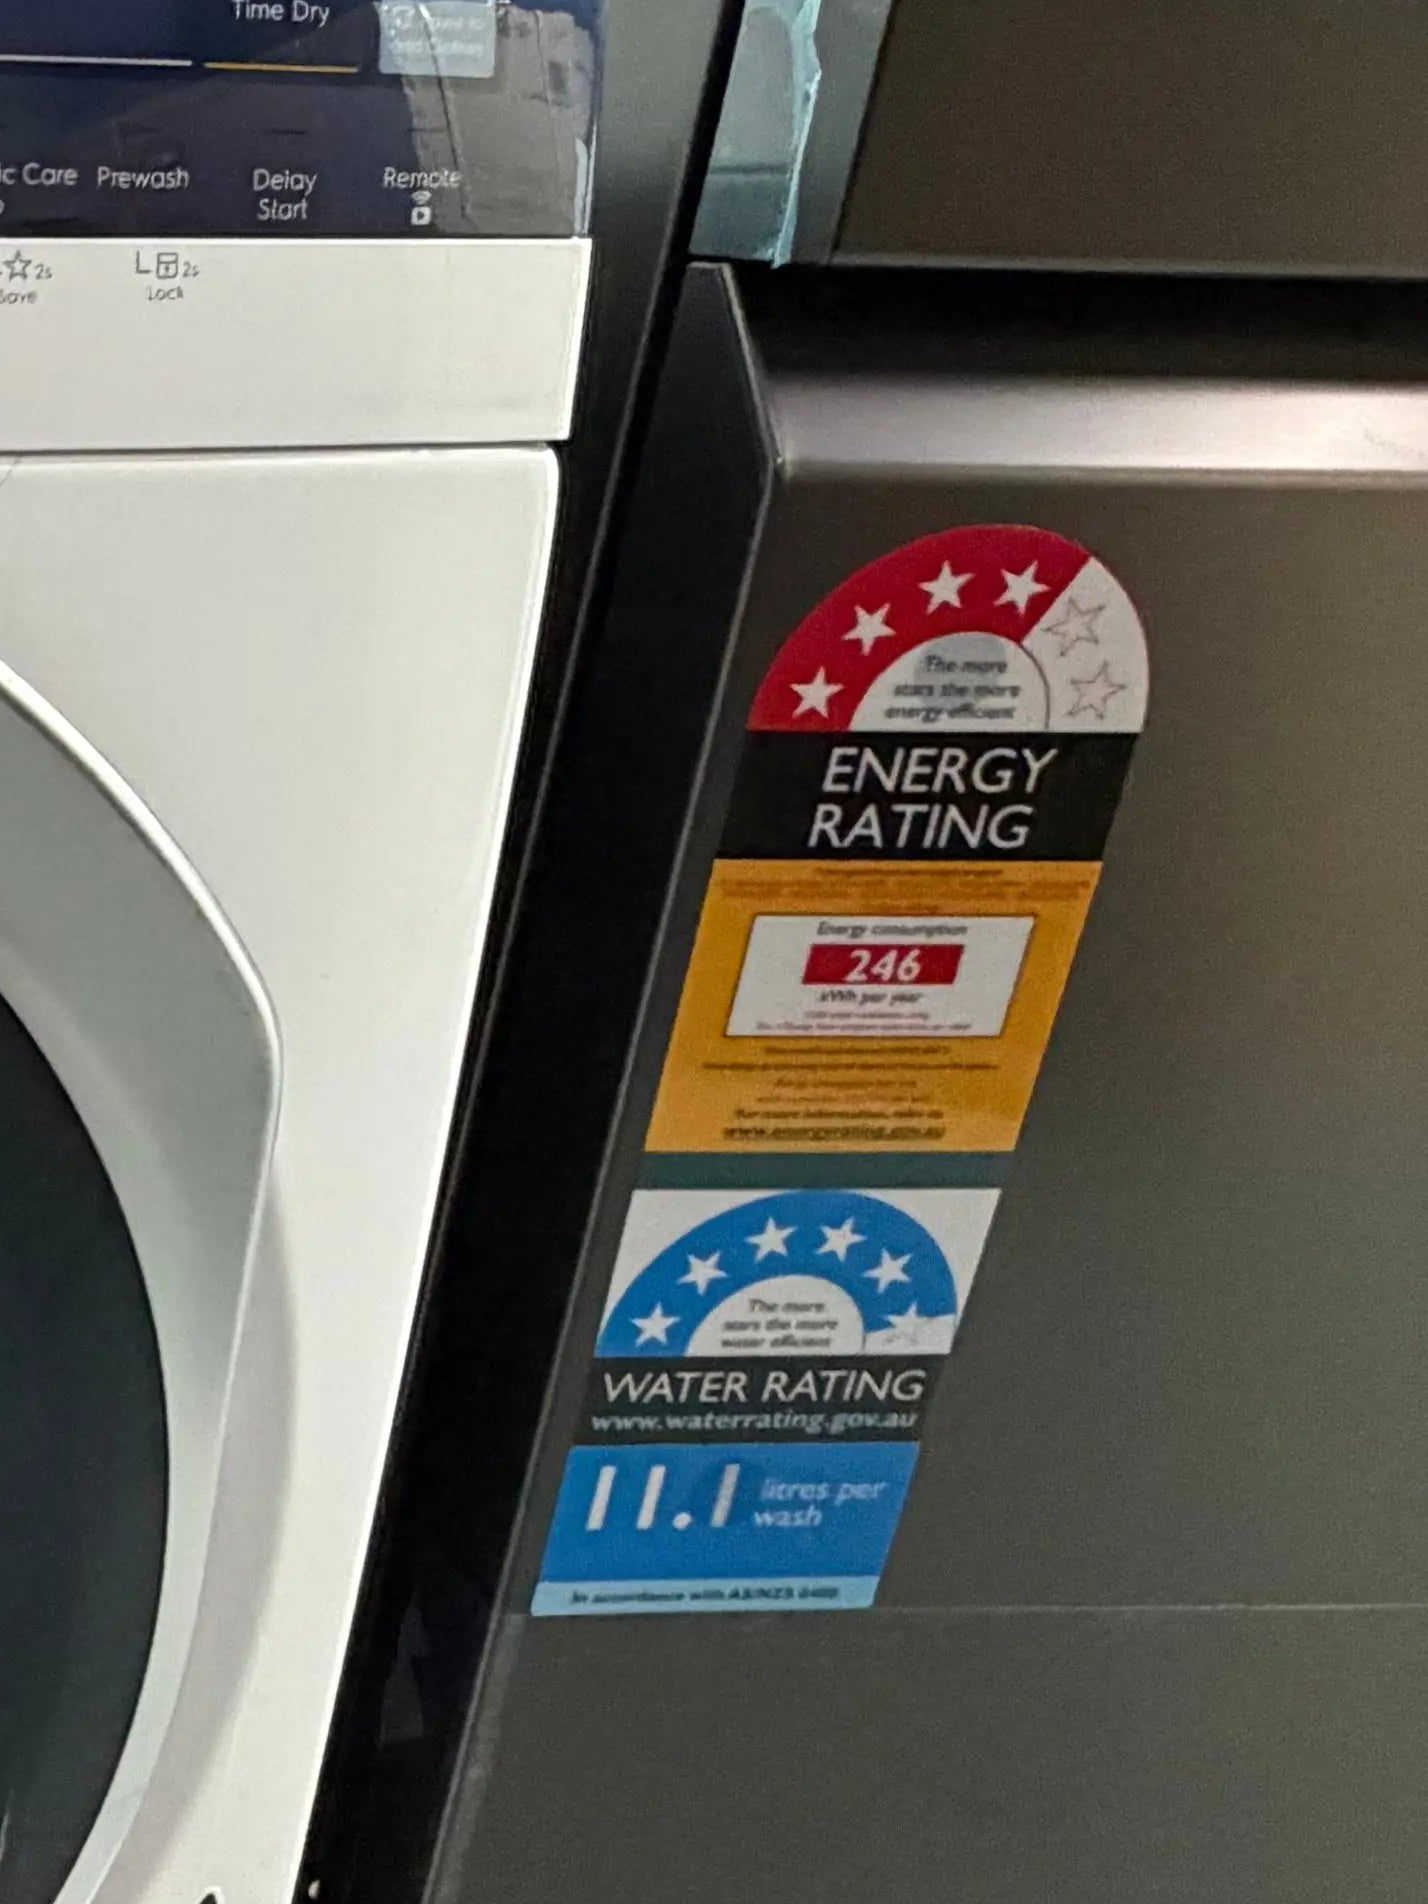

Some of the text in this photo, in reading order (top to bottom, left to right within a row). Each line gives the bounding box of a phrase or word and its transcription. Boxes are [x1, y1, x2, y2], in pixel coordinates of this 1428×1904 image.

[292, 0, 331, 28] Dry
[23, 163, 79, 188] Care
[96, 165, 190, 190] Prewash
[252, 168, 317, 197] Delay
[383, 166, 462, 189] Remote
[257, 198, 309, 223] Start
[146, 285, 184, 302] Lock
[924, 654, 1008, 675] The more
[940, 682, 970, 697] the
[974, 684, 1022, 699] more
[821, 746, 1058, 795] ENERGY
[807, 804, 1035, 850] RATING
[842, 948, 924, 984] 246
[747, 1298, 826, 1315] The more
[764, 1317, 792, 1333] the
[795, 1318, 839, 1332] more
[603, 1368, 928, 1404] WATER RATING
[591, 1410, 920, 1437] www.waterrating.gov.au
[585, 1463, 741, 1532] 11.1
[759, 1477, 887, 1505] litres per
[753, 1505, 824, 1528] wash
